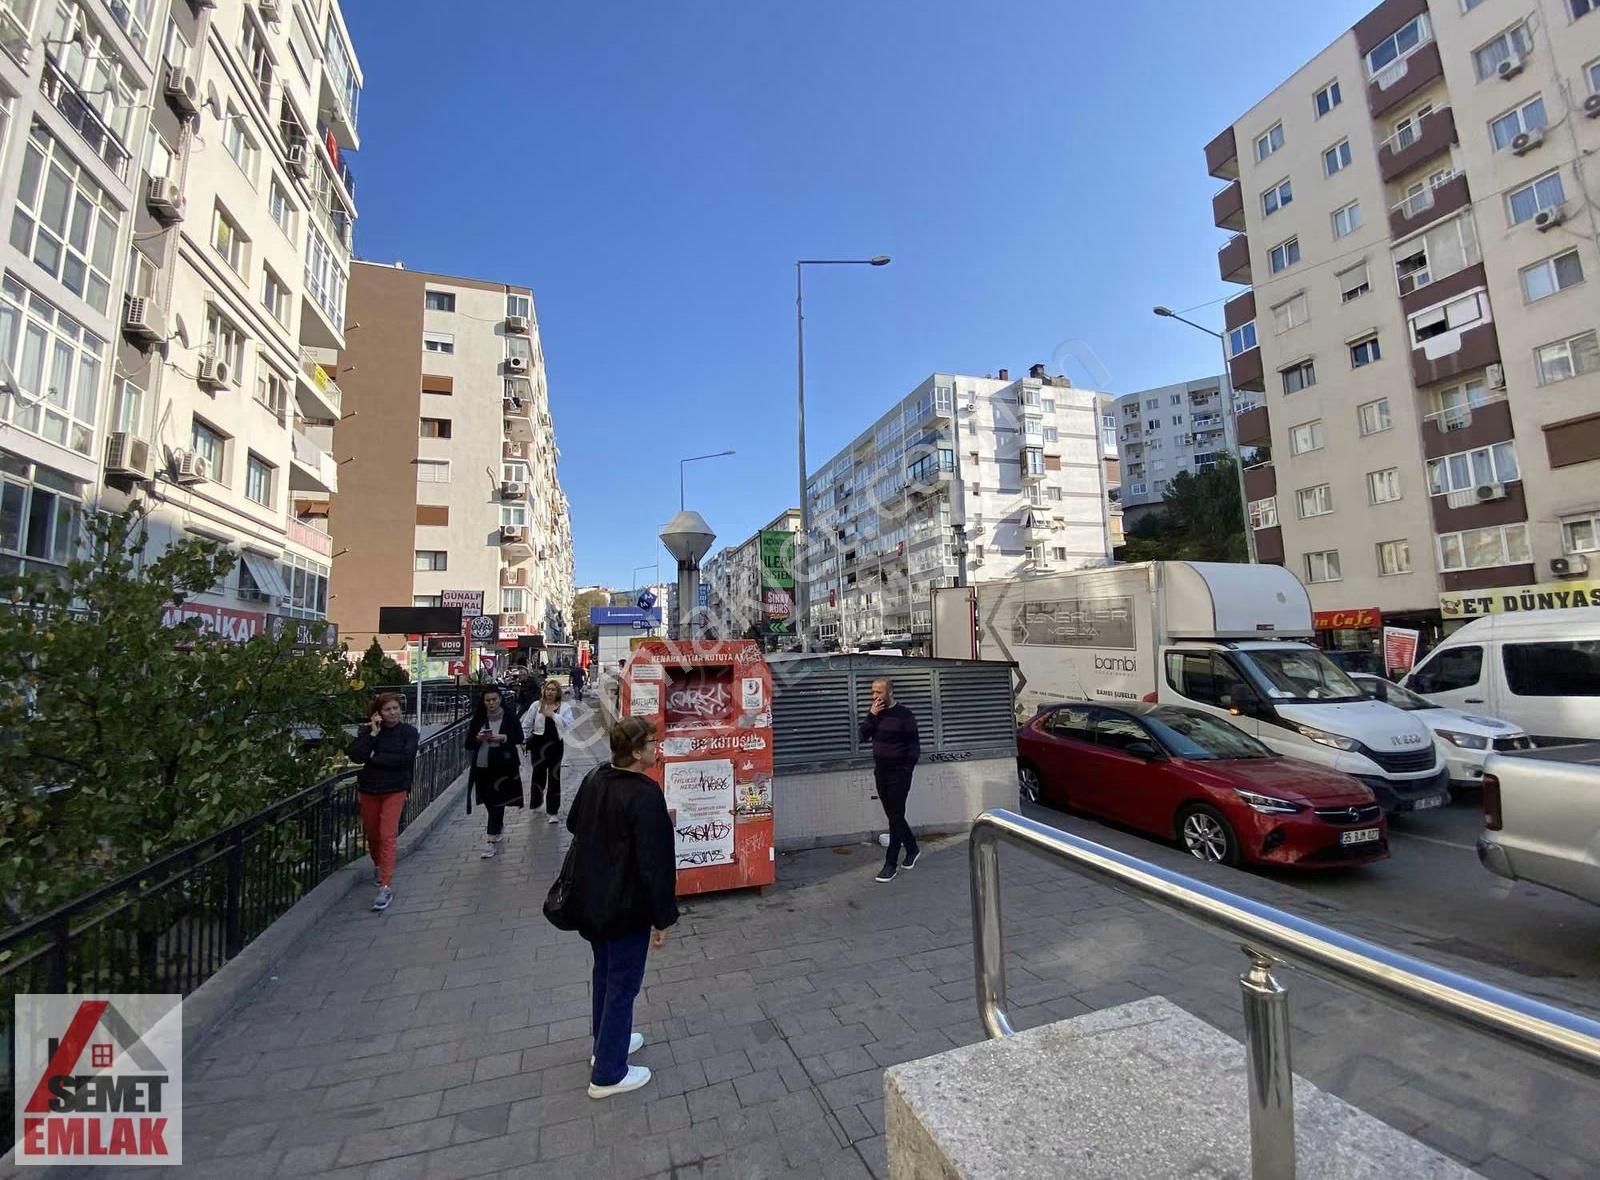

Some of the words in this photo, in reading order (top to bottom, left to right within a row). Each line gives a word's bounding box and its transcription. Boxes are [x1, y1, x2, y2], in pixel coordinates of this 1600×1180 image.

[1462, 596, 1493, 614] ET
[1503, 588, 1600, 612] DÜNYAS
[1095, 654, 1137, 671] bambi
